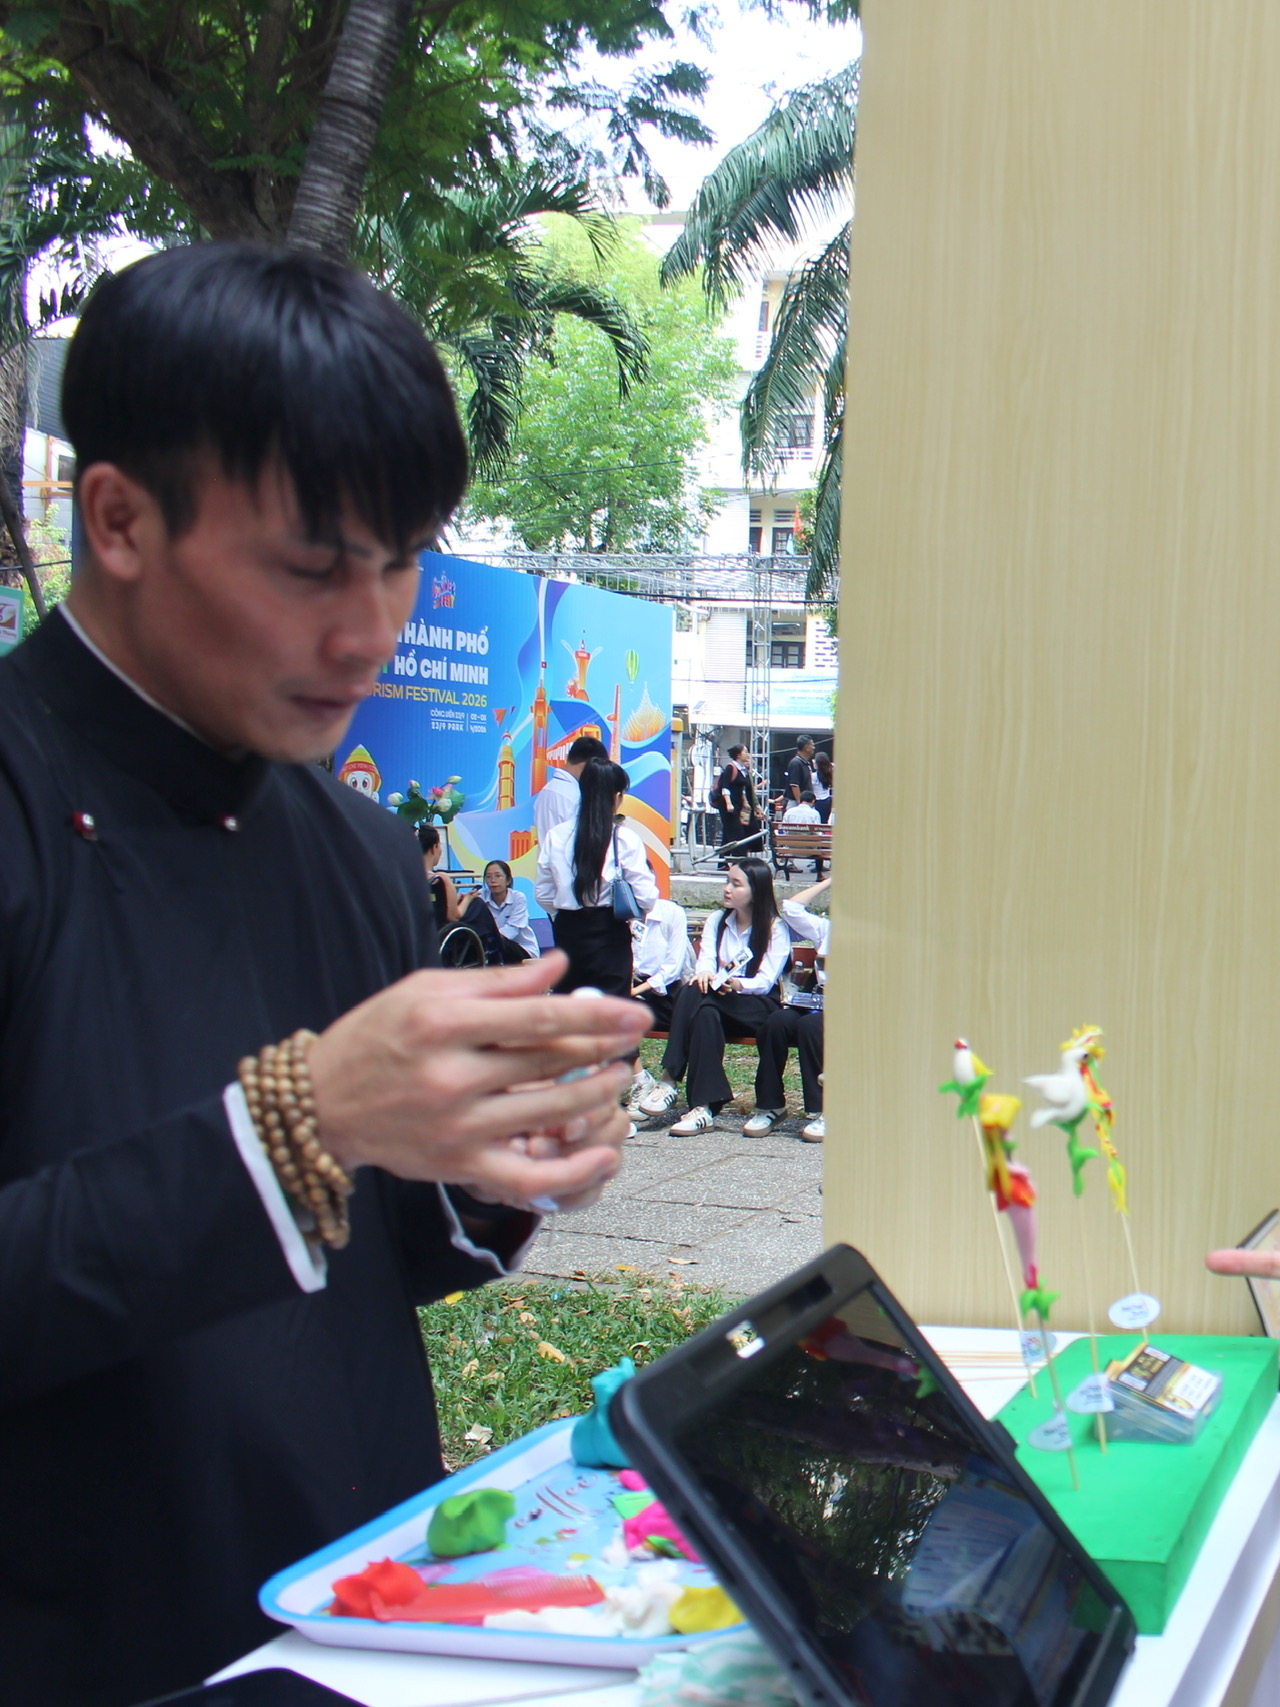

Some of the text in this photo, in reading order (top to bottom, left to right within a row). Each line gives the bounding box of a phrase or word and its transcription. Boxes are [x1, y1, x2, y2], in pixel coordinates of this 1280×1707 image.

[397, 618, 489, 655] HÀNH PHỐ
[394, 649, 418, 677] HỒ
[420, 656, 447, 680] CHÍ
[450, 662, 489, 685] MINH
[366, 682, 487, 707] RISM FESTIVAL 2026
[447, 722, 464, 731] PARK
